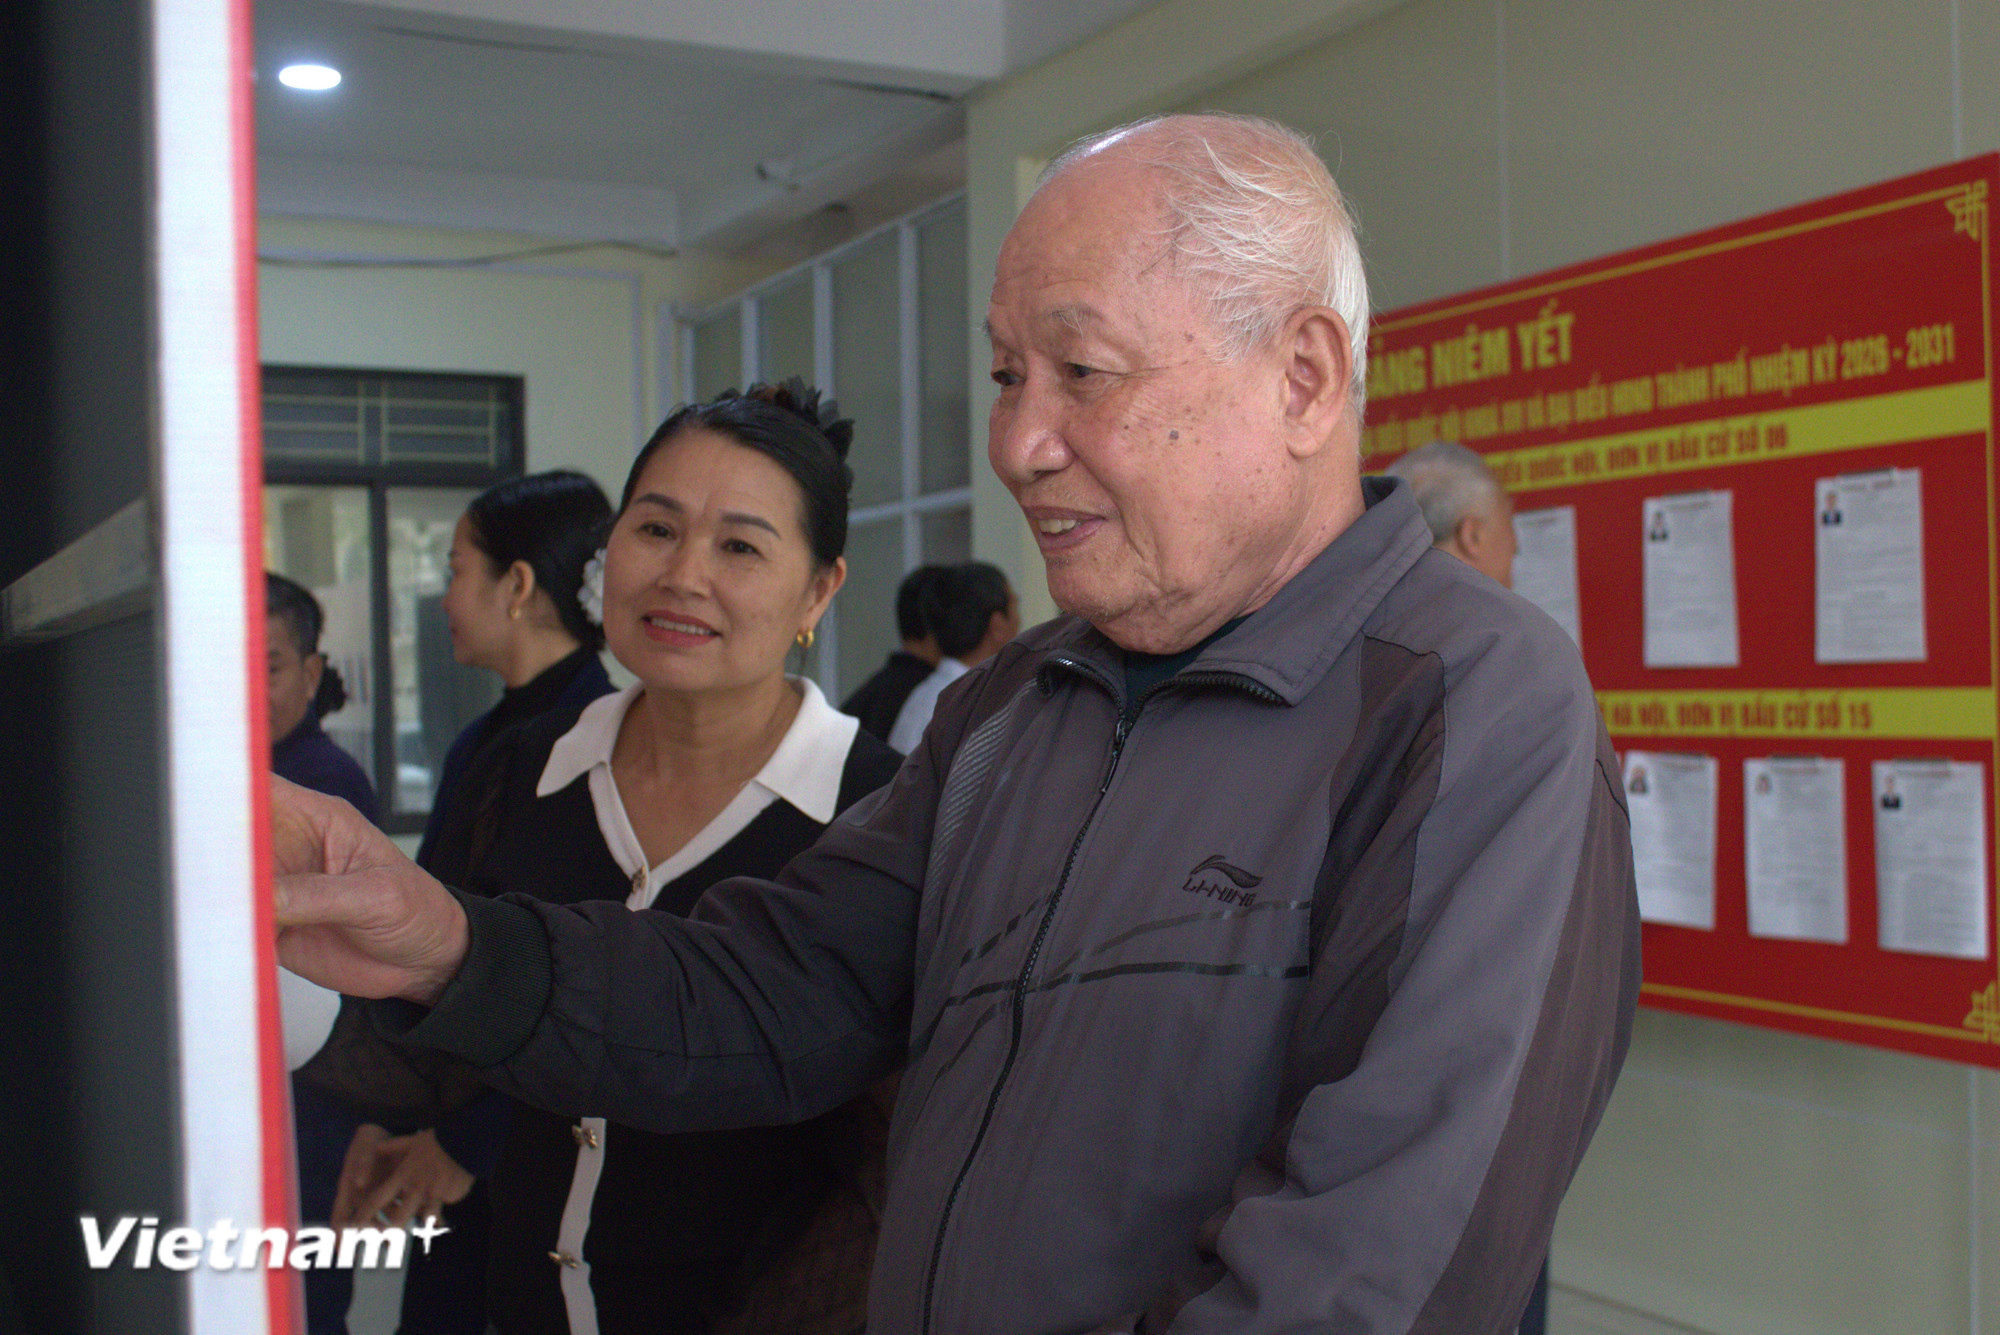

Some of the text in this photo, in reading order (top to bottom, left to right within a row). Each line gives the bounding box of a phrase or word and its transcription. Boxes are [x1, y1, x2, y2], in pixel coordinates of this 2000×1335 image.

[1366, 298, 1575, 398] ẢNG NIÊM YẾT
[1712, 347, 1748, 398] PHỐ
[1750, 343, 1810, 396] NHIỆM
[1812, 335, 1837, 384] KỲ
[1841, 334, 1889, 380] 2026
[1906, 322, 1954, 369] 2031
[1736, 418, 1759, 455] SỐ
[1741, 692, 1777, 728] BẦU
[1783, 691, 1810, 728] CỬ
[1815, 690, 1841, 729] SỐ
[1850, 702, 1873, 730] 15
